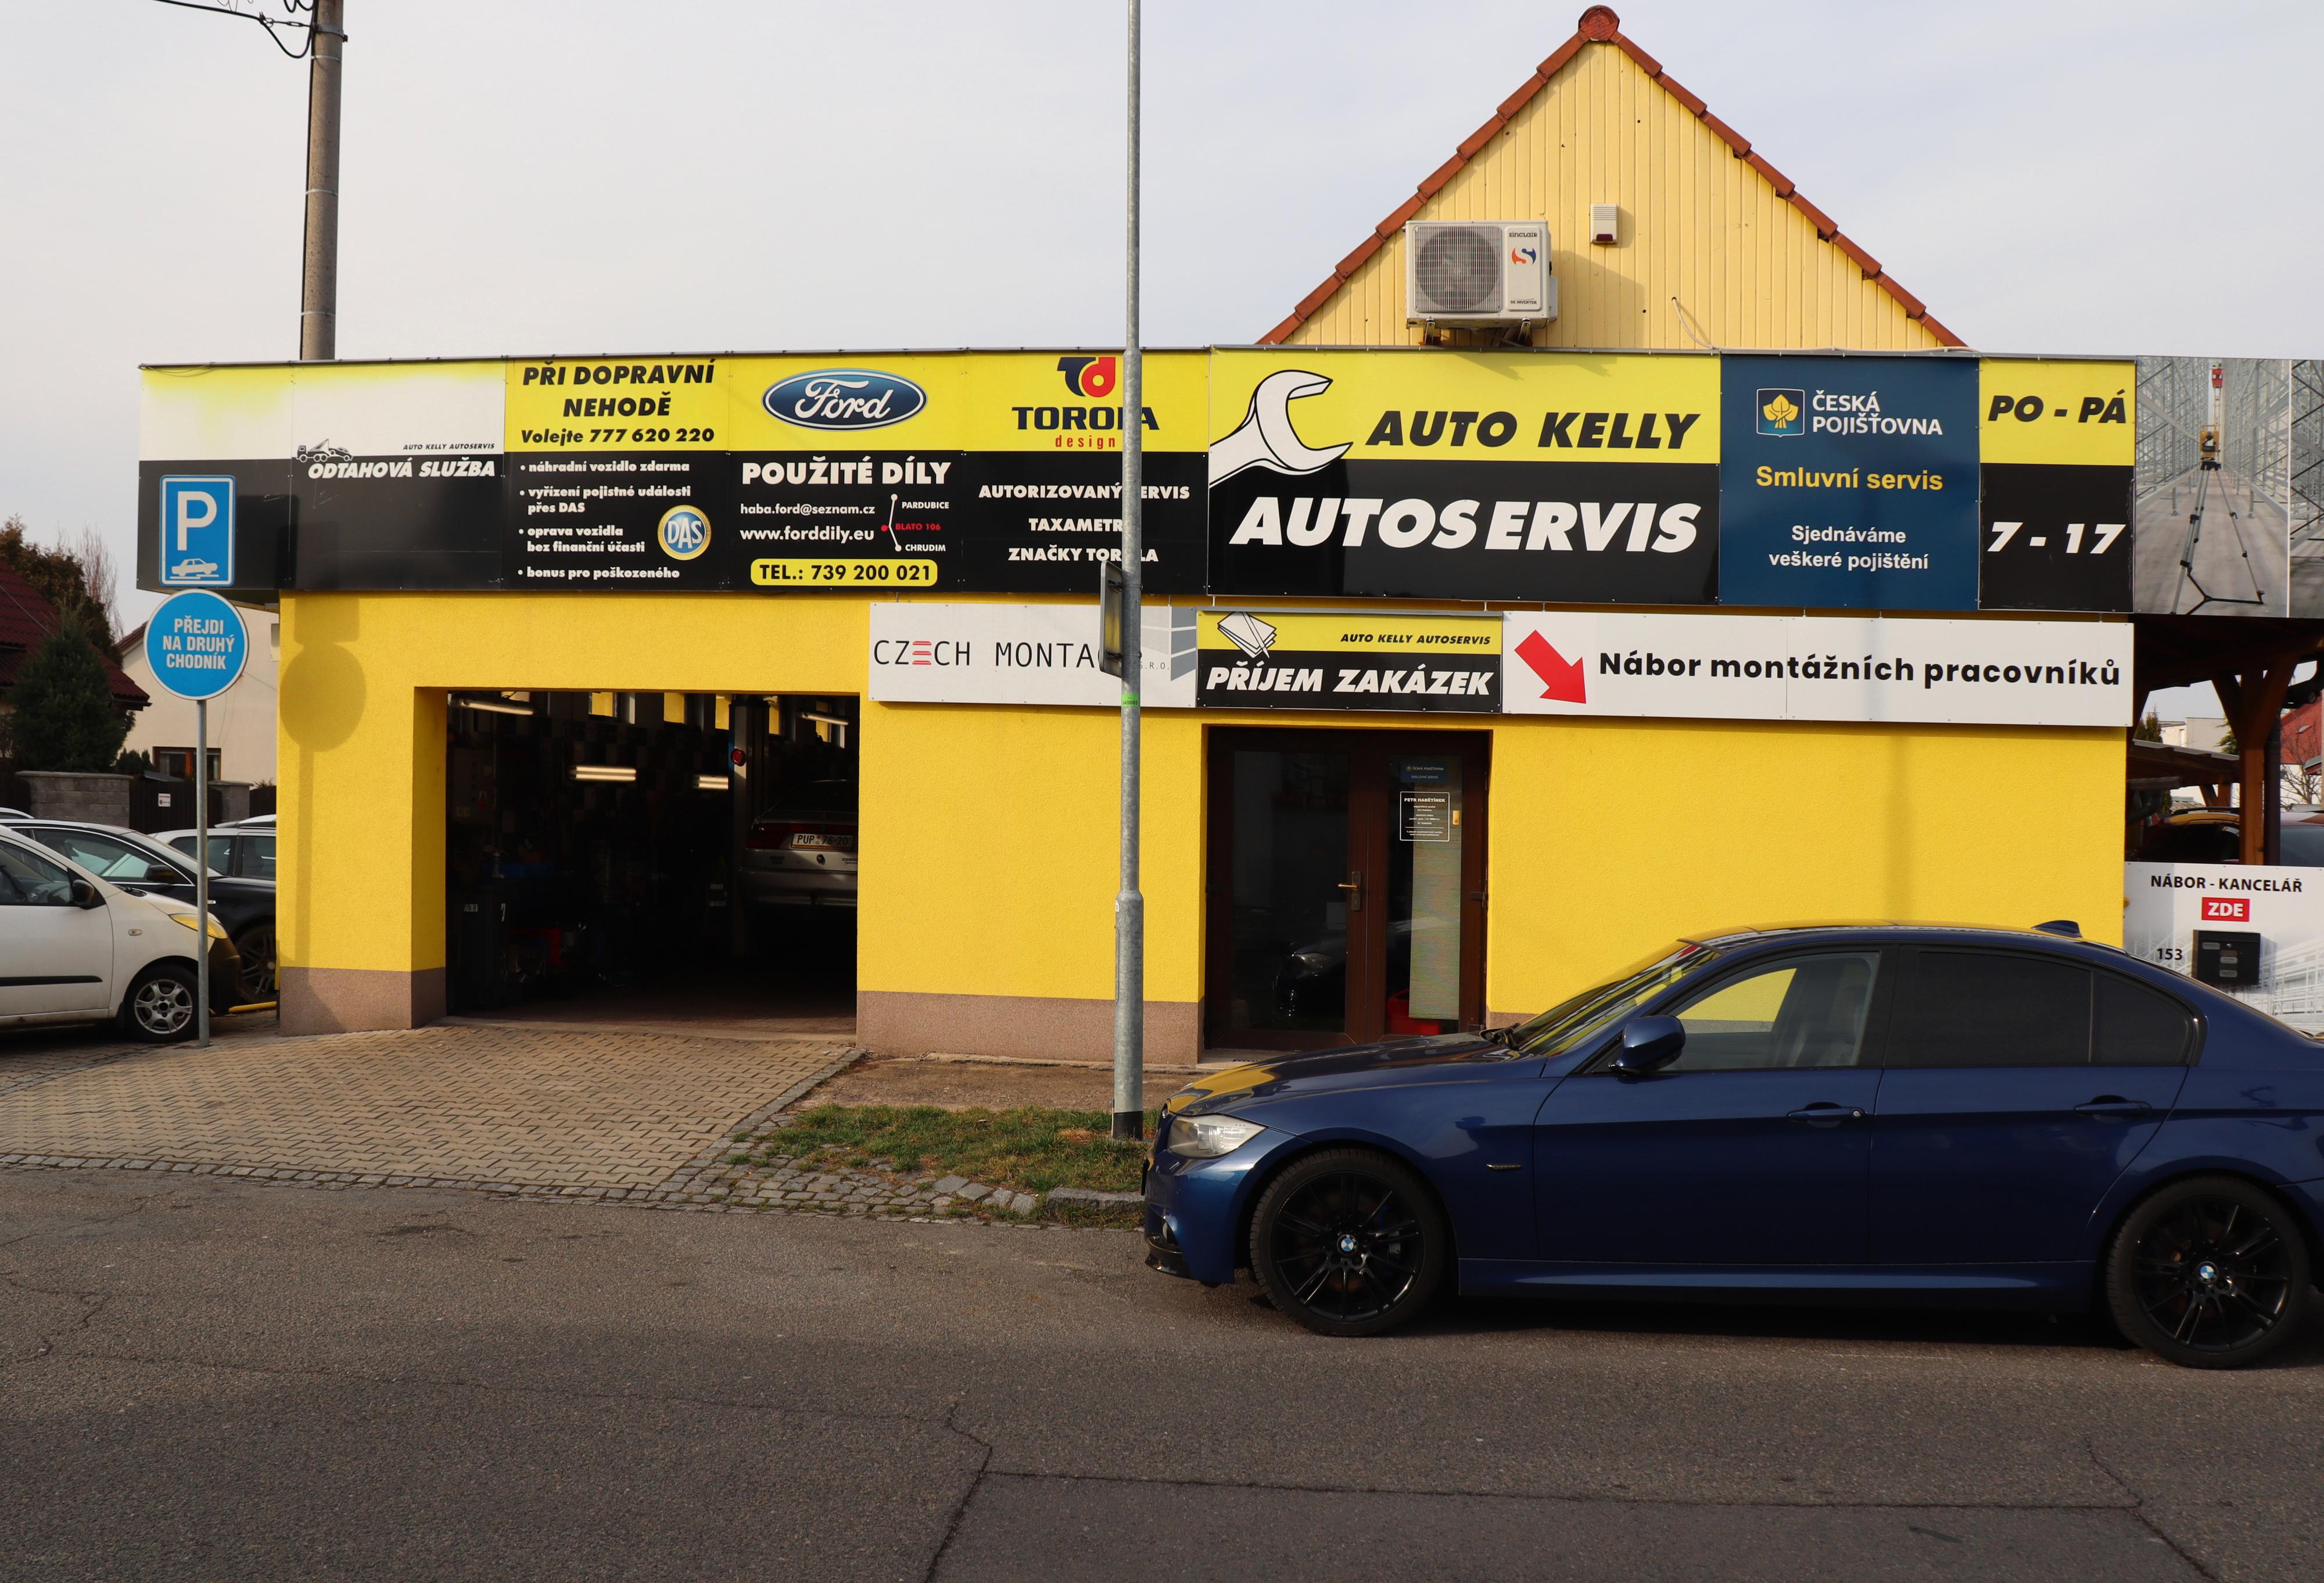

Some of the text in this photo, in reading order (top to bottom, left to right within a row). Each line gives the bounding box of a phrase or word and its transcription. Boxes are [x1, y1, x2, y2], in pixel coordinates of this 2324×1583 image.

[523, 358, 716, 385] PŘI DOPRAVNÍ
[563, 391, 671, 417] NEHODĚ
[795, 379, 894, 418] Ford
[1812, 389, 1880, 412] ČESKÁ
[1988, 395, 2044, 422] PO
[2078, 389, 2126, 424] PÁ
[1012, 407, 1160, 430] TOROA
[1813, 413, 1943, 436] POJIŠŤOVNA
[521, 428, 715, 446] Volejte 777 620 220
[1365, 411, 1701, 449] AUTO KELLY
[1055, 435, 1116, 449] design
[308, 457, 495, 479] ODTAHOVÁ SLUŽBA
[529, 460, 690, 472] náhradní vozidlo zdarma
[742, 456, 951, 484] POUŽITÉ DÍLY
[1756, 465, 1943, 490] Smluvní servis
[528, 485, 691, 499] vyřízení pojistné události
[978, 482, 1190, 499] AUTORIZOVANÝ ERVIS
[528, 502, 585, 515] přes DAS
[740, 504, 875, 515] haba.ford@seznam.cz
[901, 502, 949, 510] PARDUBICE
[177, 491, 217, 551] P
[1028, 518, 1123, 532] TAXAMETR
[1229, 496, 1702, 553] AUTOSERVIS
[528, 525, 623, 539] oprava vozidla
[668, 517, 702, 549] DAS
[740, 526, 874, 543] www.forddily.eu
[1792, 525, 1906, 545] Sjednáváme
[1987, 522, 2023, 552] 7
[2065, 524, 2127, 554] 17
[527, 541, 645, 552] bez finanční účasti
[1008, 545, 1159, 562] ZNAČKY TORLA
[1769, 550, 1929, 572] veškeré pojištění
[527, 566, 680, 580] bonus pro poškozeného
[759, 565, 930, 580] TEL.: 739 200 021
[174, 615, 224, 634] PŘEJDI
[163, 635, 235, 653] NA DRUHÝ
[1340, 634, 1491, 644] AUTO KELLY AUTOSERVIS
[166, 653, 226, 669] CHODNÍK
[873, 639, 970, 666] CZECH
[995, 642, 1100, 668] MONTA
[1206, 660, 1494, 696] PŘÍJEM ZAKÁZEK
[1599, 652, 2120, 688] Nábor montážních pracovníků
[797, 835, 848, 846] PUP 76-20
[2151, 873, 2205, 889] NÁBOR
[2219, 878, 2302, 892] KANCELÁŘ
[2208, 902, 2243, 916] ZDE
[2157, 948, 2182, 960] 153
